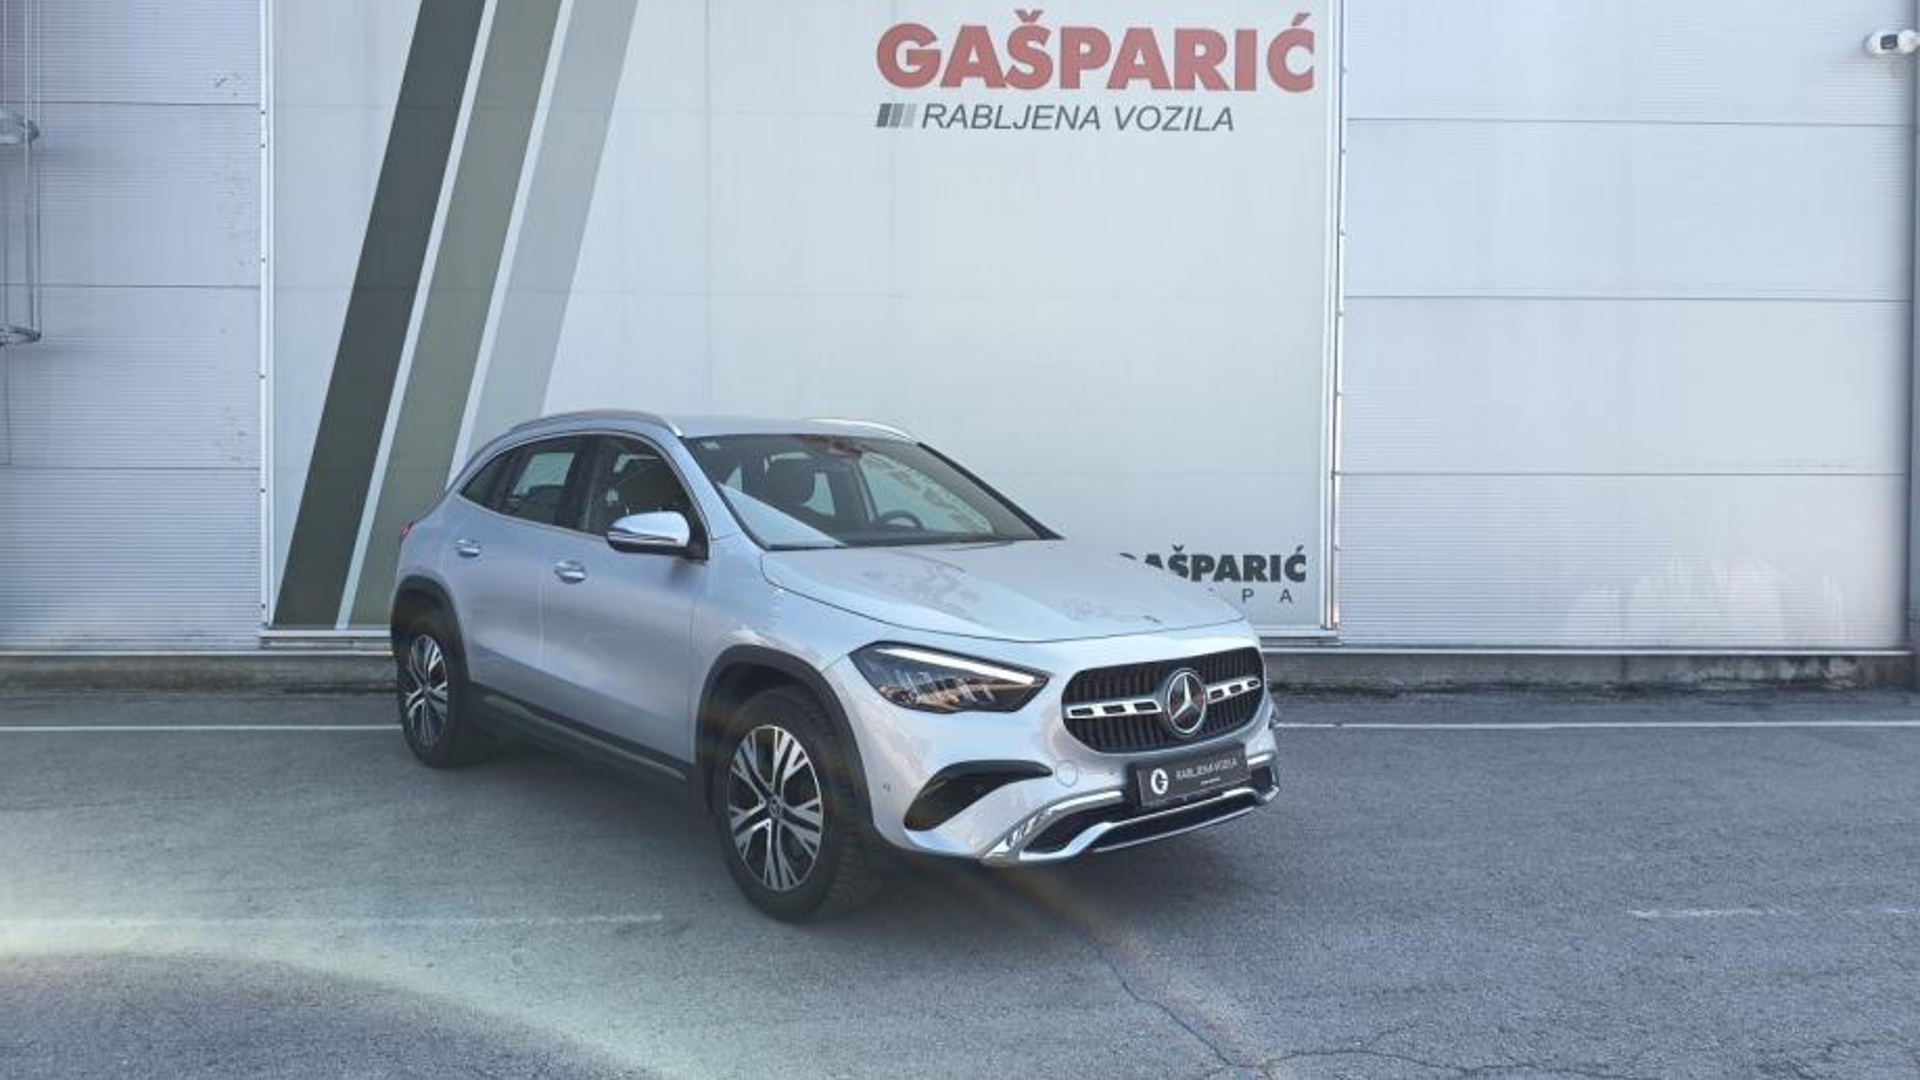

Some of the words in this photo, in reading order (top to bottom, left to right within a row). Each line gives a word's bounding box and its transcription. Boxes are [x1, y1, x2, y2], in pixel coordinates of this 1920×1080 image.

[876, 9, 1314, 93] GAŠPARIĆ
[921, 103, 1101, 131] RABLJENA
[1114, 105, 1235, 132] VOZILA
[1119, 545, 1307, 582] ŠPARIĆ
